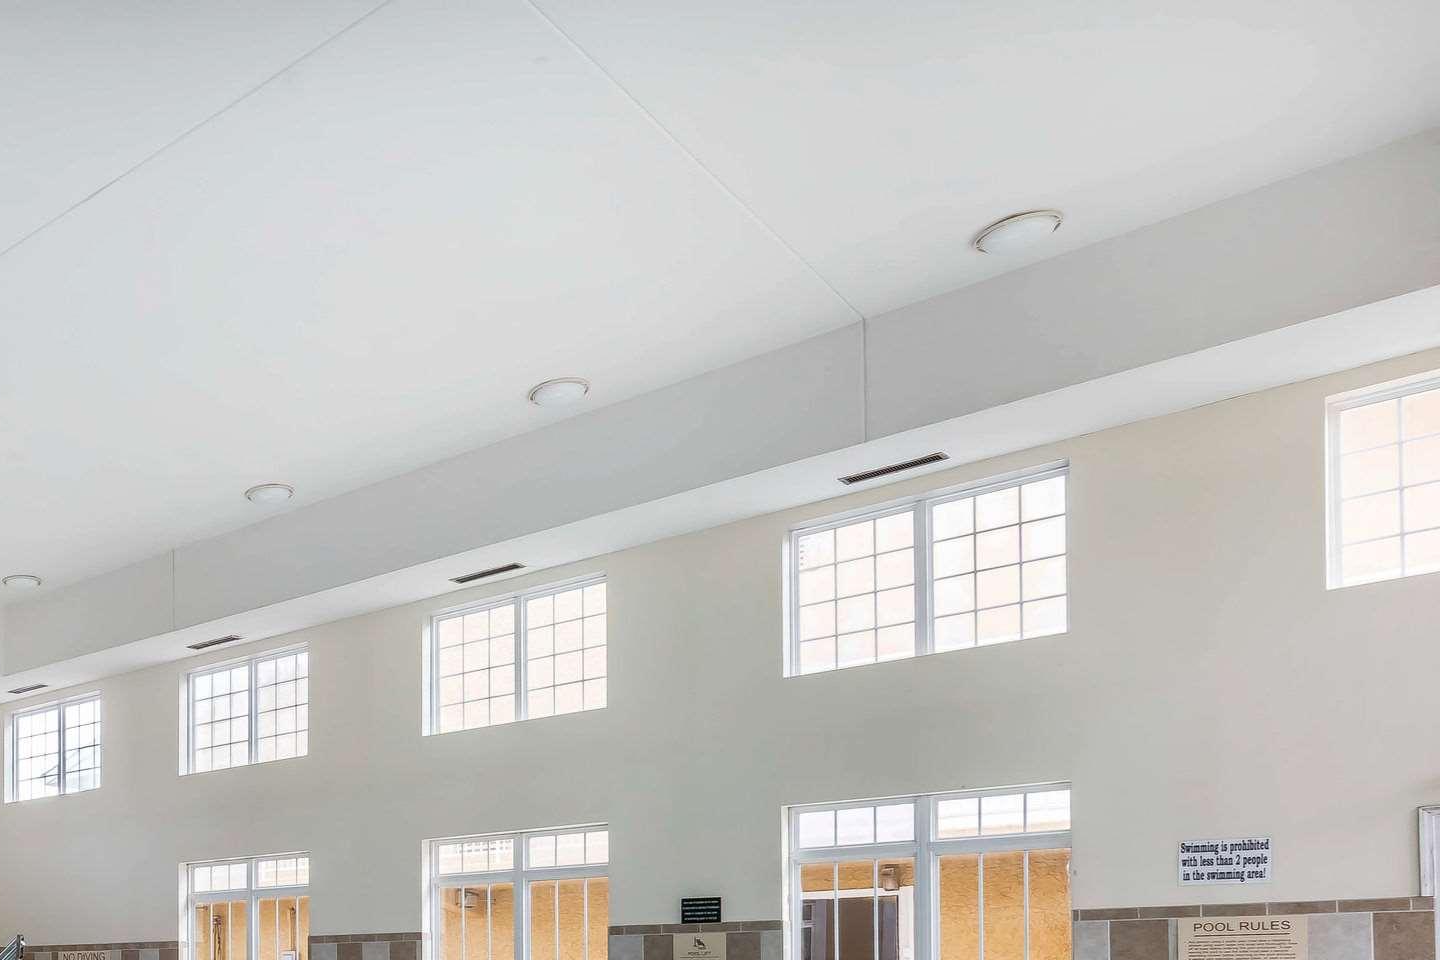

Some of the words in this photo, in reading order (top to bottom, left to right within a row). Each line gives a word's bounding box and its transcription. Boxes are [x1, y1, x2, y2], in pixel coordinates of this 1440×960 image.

[1180, 841, 1219, 855] Swimming
[1221, 840, 1228, 852] is
[1229, 838, 1270, 854] prohibited
[1181, 856, 1198, 867] with
[1200, 855, 1214, 866] less
[1216, 855, 1234, 866] than
[1235, 854, 1241, 865] 2
[1243, 853, 1268, 868] people
[1182, 870, 1191, 881] in
[1192, 869, 1205, 880] the
[1206, 868, 1245, 882] swimming
[1246, 867, 1266, 879] area!
[1193, 922, 1235, 932] POOL
[1240, 920, 1291, 931] RULES
[77, 952, 106, 960] DIVING
